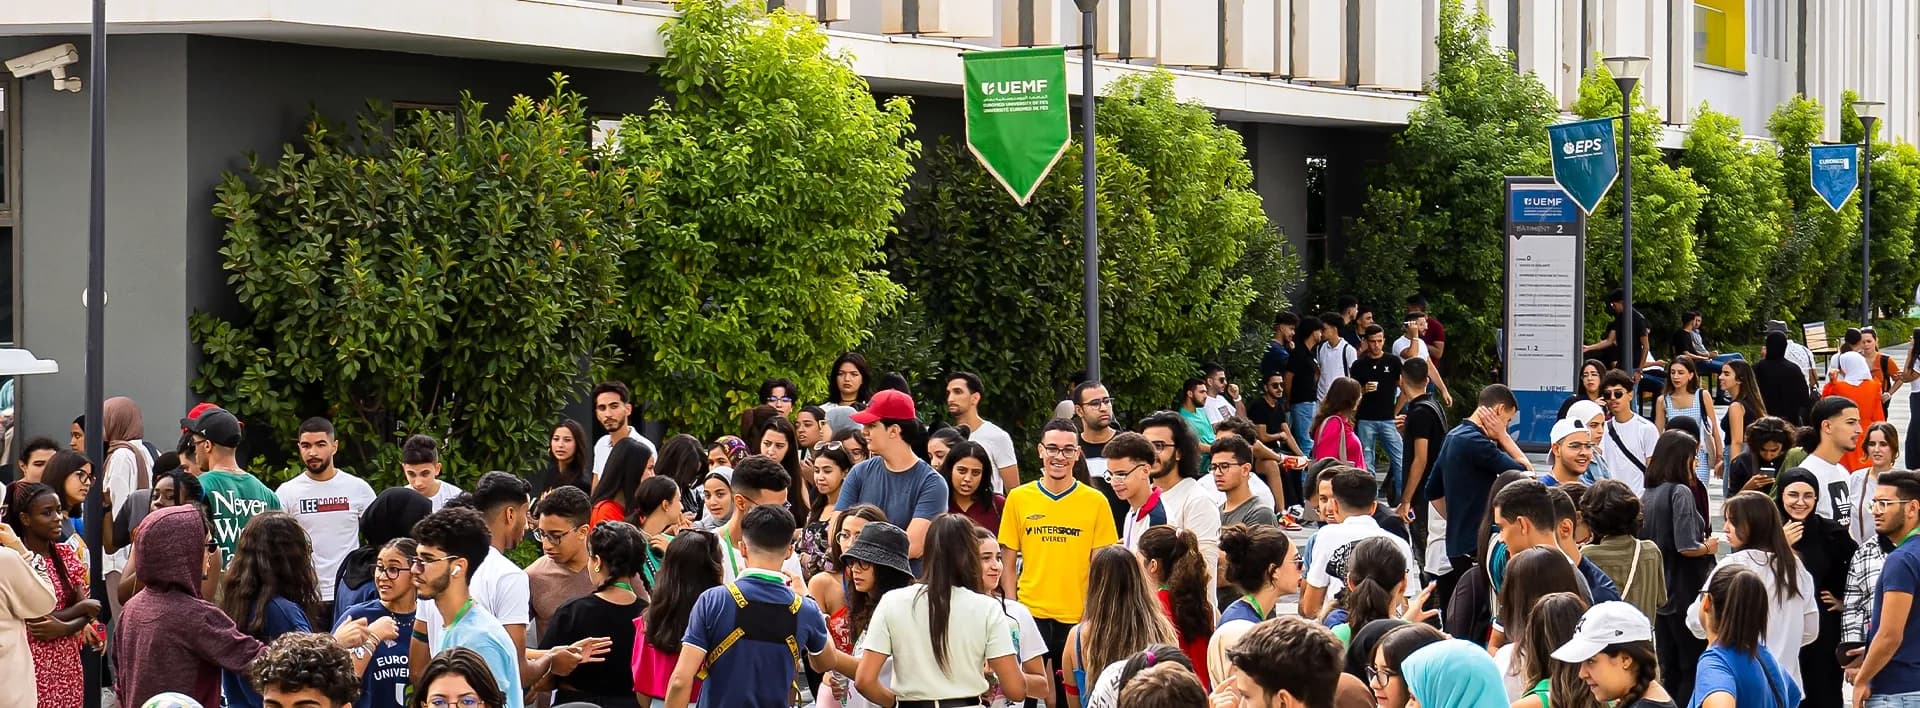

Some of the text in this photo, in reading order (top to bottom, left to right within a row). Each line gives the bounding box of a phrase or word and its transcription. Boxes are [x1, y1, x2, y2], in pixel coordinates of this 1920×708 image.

[997, 79, 1048, 95] UEMF
[1575, 138, 1602, 154] EPS
[1532, 197, 1563, 206] UEMF
[1556, 224, 1563, 234] 2
[210, 489, 268, 517] Never
[300, 499, 318, 513] LEE
[1033, 525, 1081, 536] INTERSPORT
[1041, 535, 1067, 543] EVEREST
